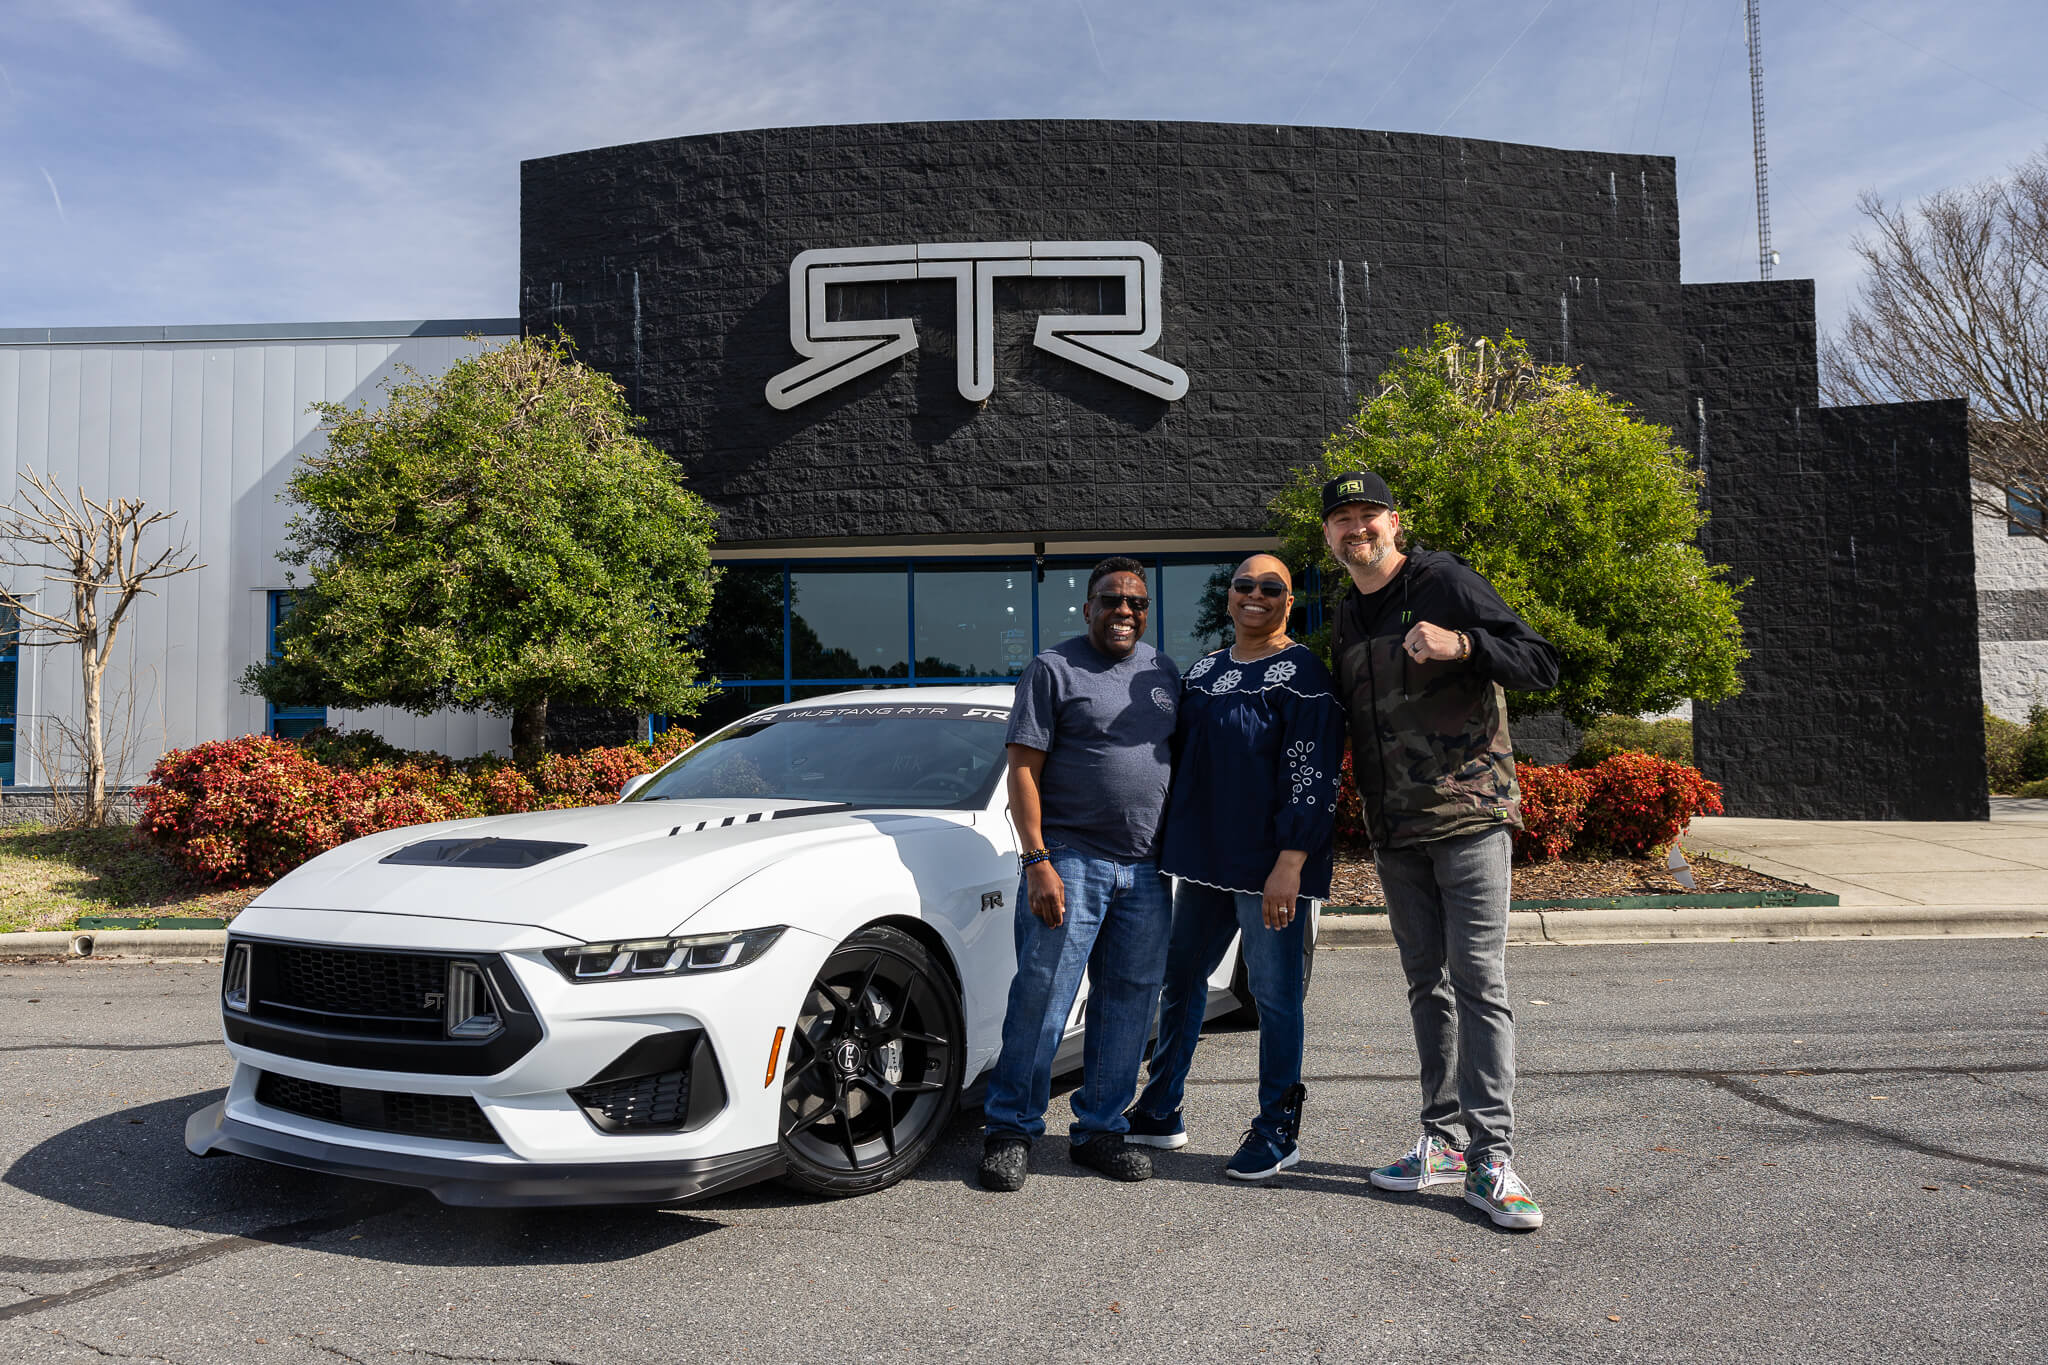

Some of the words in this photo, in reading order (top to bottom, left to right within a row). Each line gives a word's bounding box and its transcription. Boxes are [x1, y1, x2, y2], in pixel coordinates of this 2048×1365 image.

[765, 240, 1190, 410] RTR
[786, 707, 894, 719] MUSTANG
[896, 707, 948, 715] RTR
[962, 708, 1010, 720] RTR
[981, 890, 1004, 912] RTR
[423, 992, 445, 1009] RT
